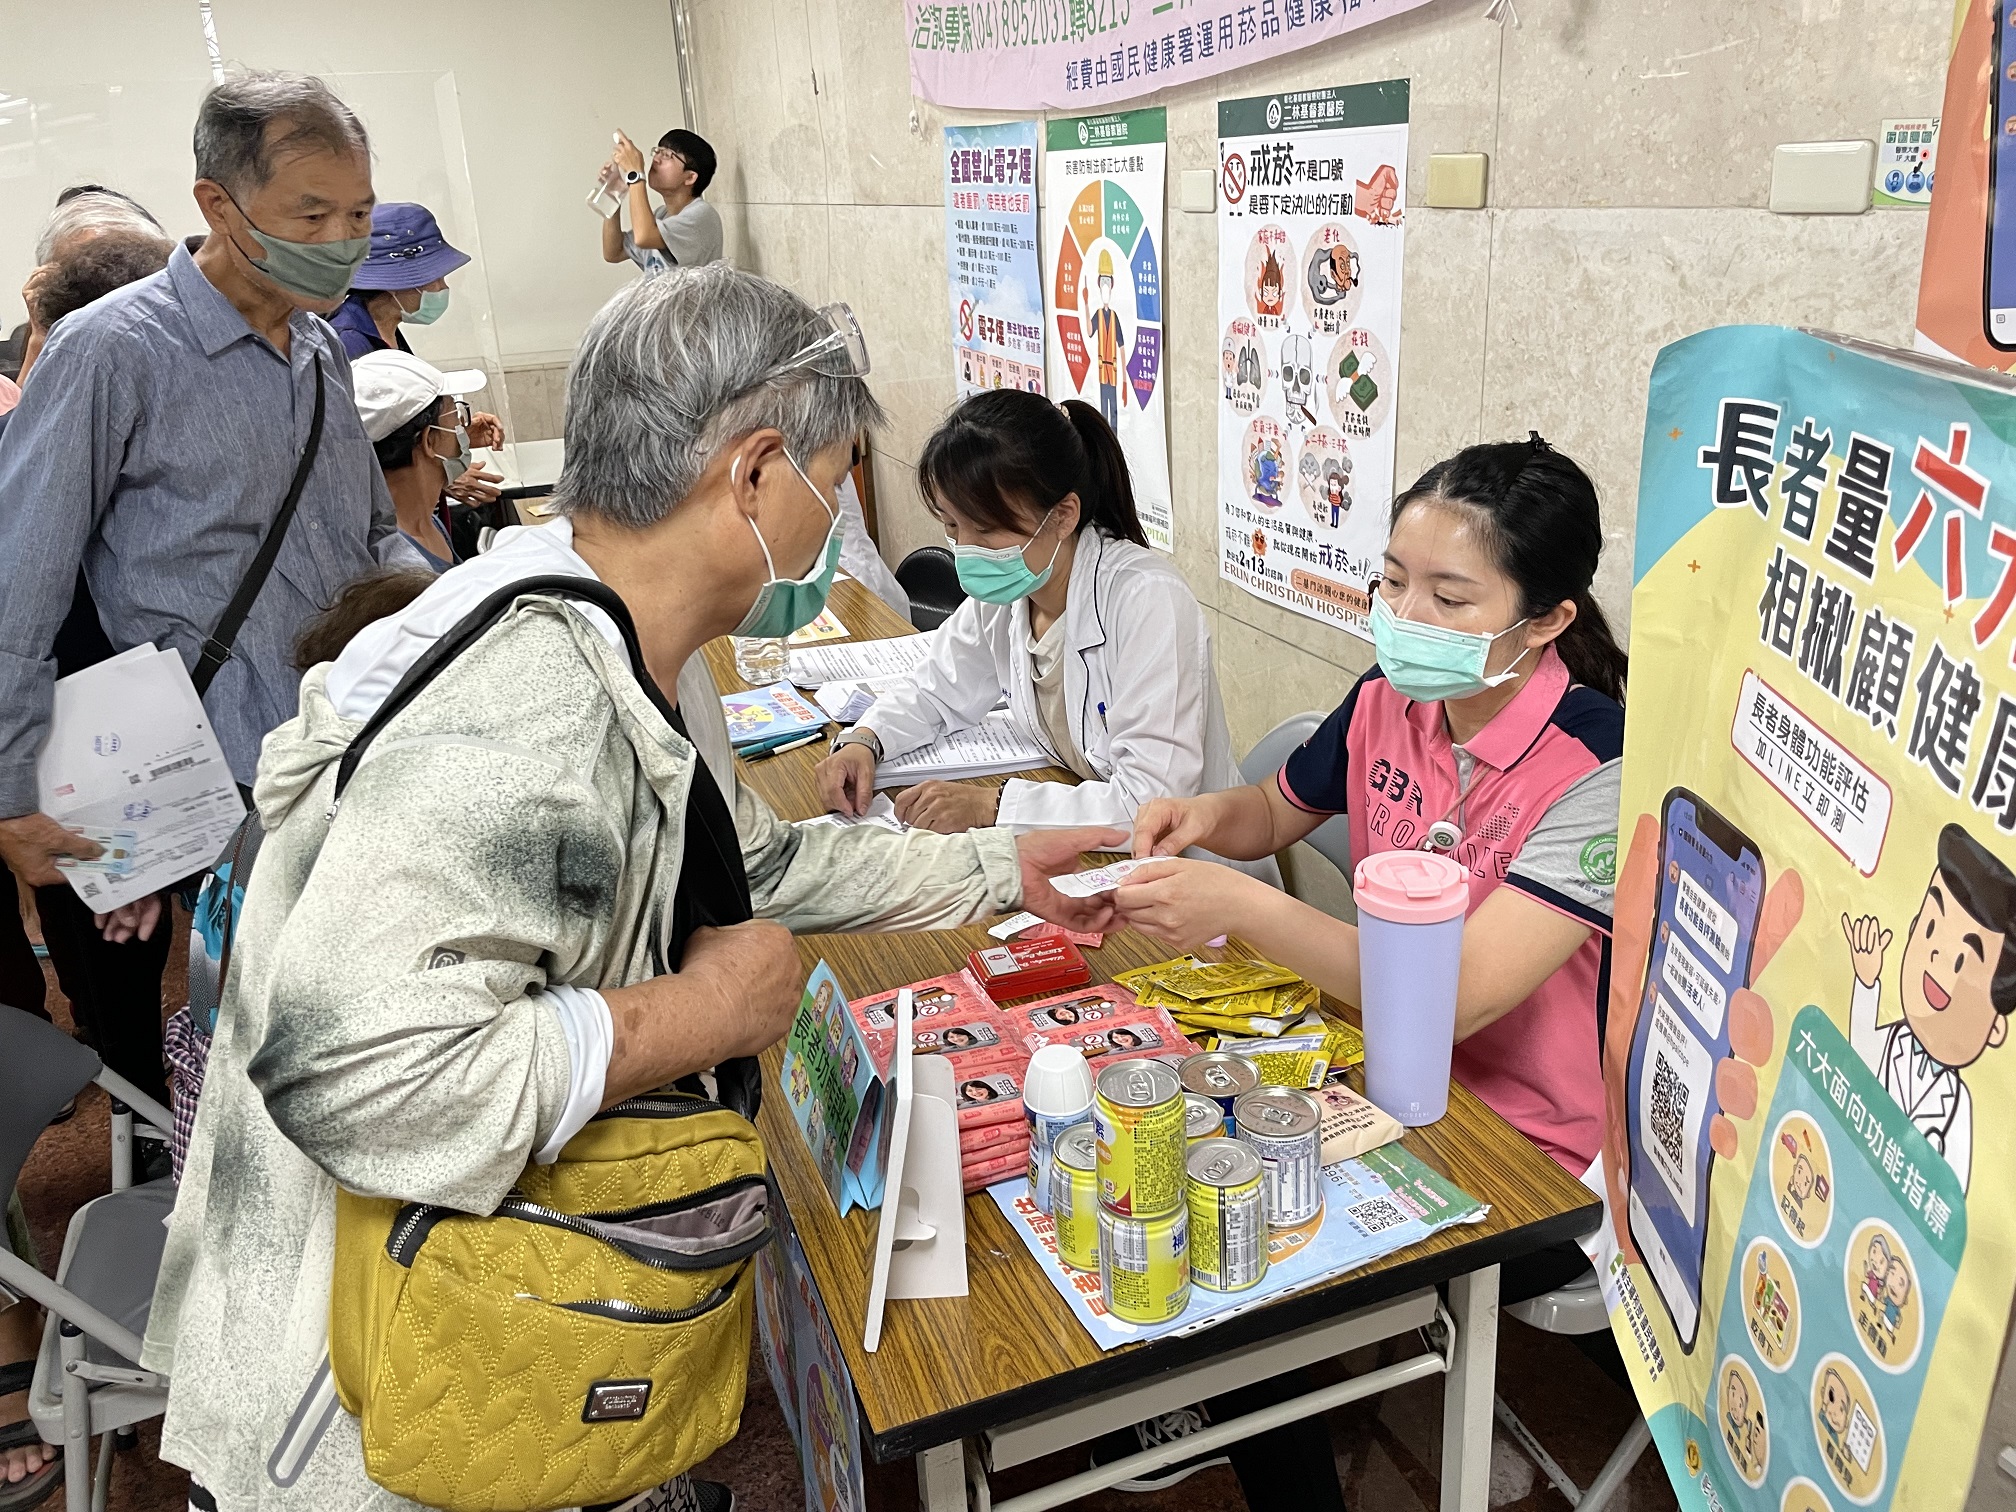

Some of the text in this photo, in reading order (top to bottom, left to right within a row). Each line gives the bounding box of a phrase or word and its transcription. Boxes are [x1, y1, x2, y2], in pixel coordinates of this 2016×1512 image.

[1066, 0, 1376, 92] 經費由國民健康署運用菸品健康
[1284, 100, 1344, 119] 二林基督教醫院
[1089, 124, 1128, 137] 二林基督教醫院
[950, 148, 1031, 184] 全面禁止電子煙
[1249, 193, 1352, 216] 是要下定決心的行動
[1324, 227, 1340, 243] 老化
[978, 314, 1005, 346] 電子煙
[1224, 562, 1249, 583] ERLIN
[1251, 574, 1314, 611] CHRISTIAN
[1317, 600, 1361, 626] HOSPI
[1750, 692, 1870, 813] 長者身體功能評估
[1795, 1029, 1953, 1240] 六大面向功能指標
[1781, 1195, 1805, 1237] 記得起
[1751, 1317, 1774, 1358] 吃得下
